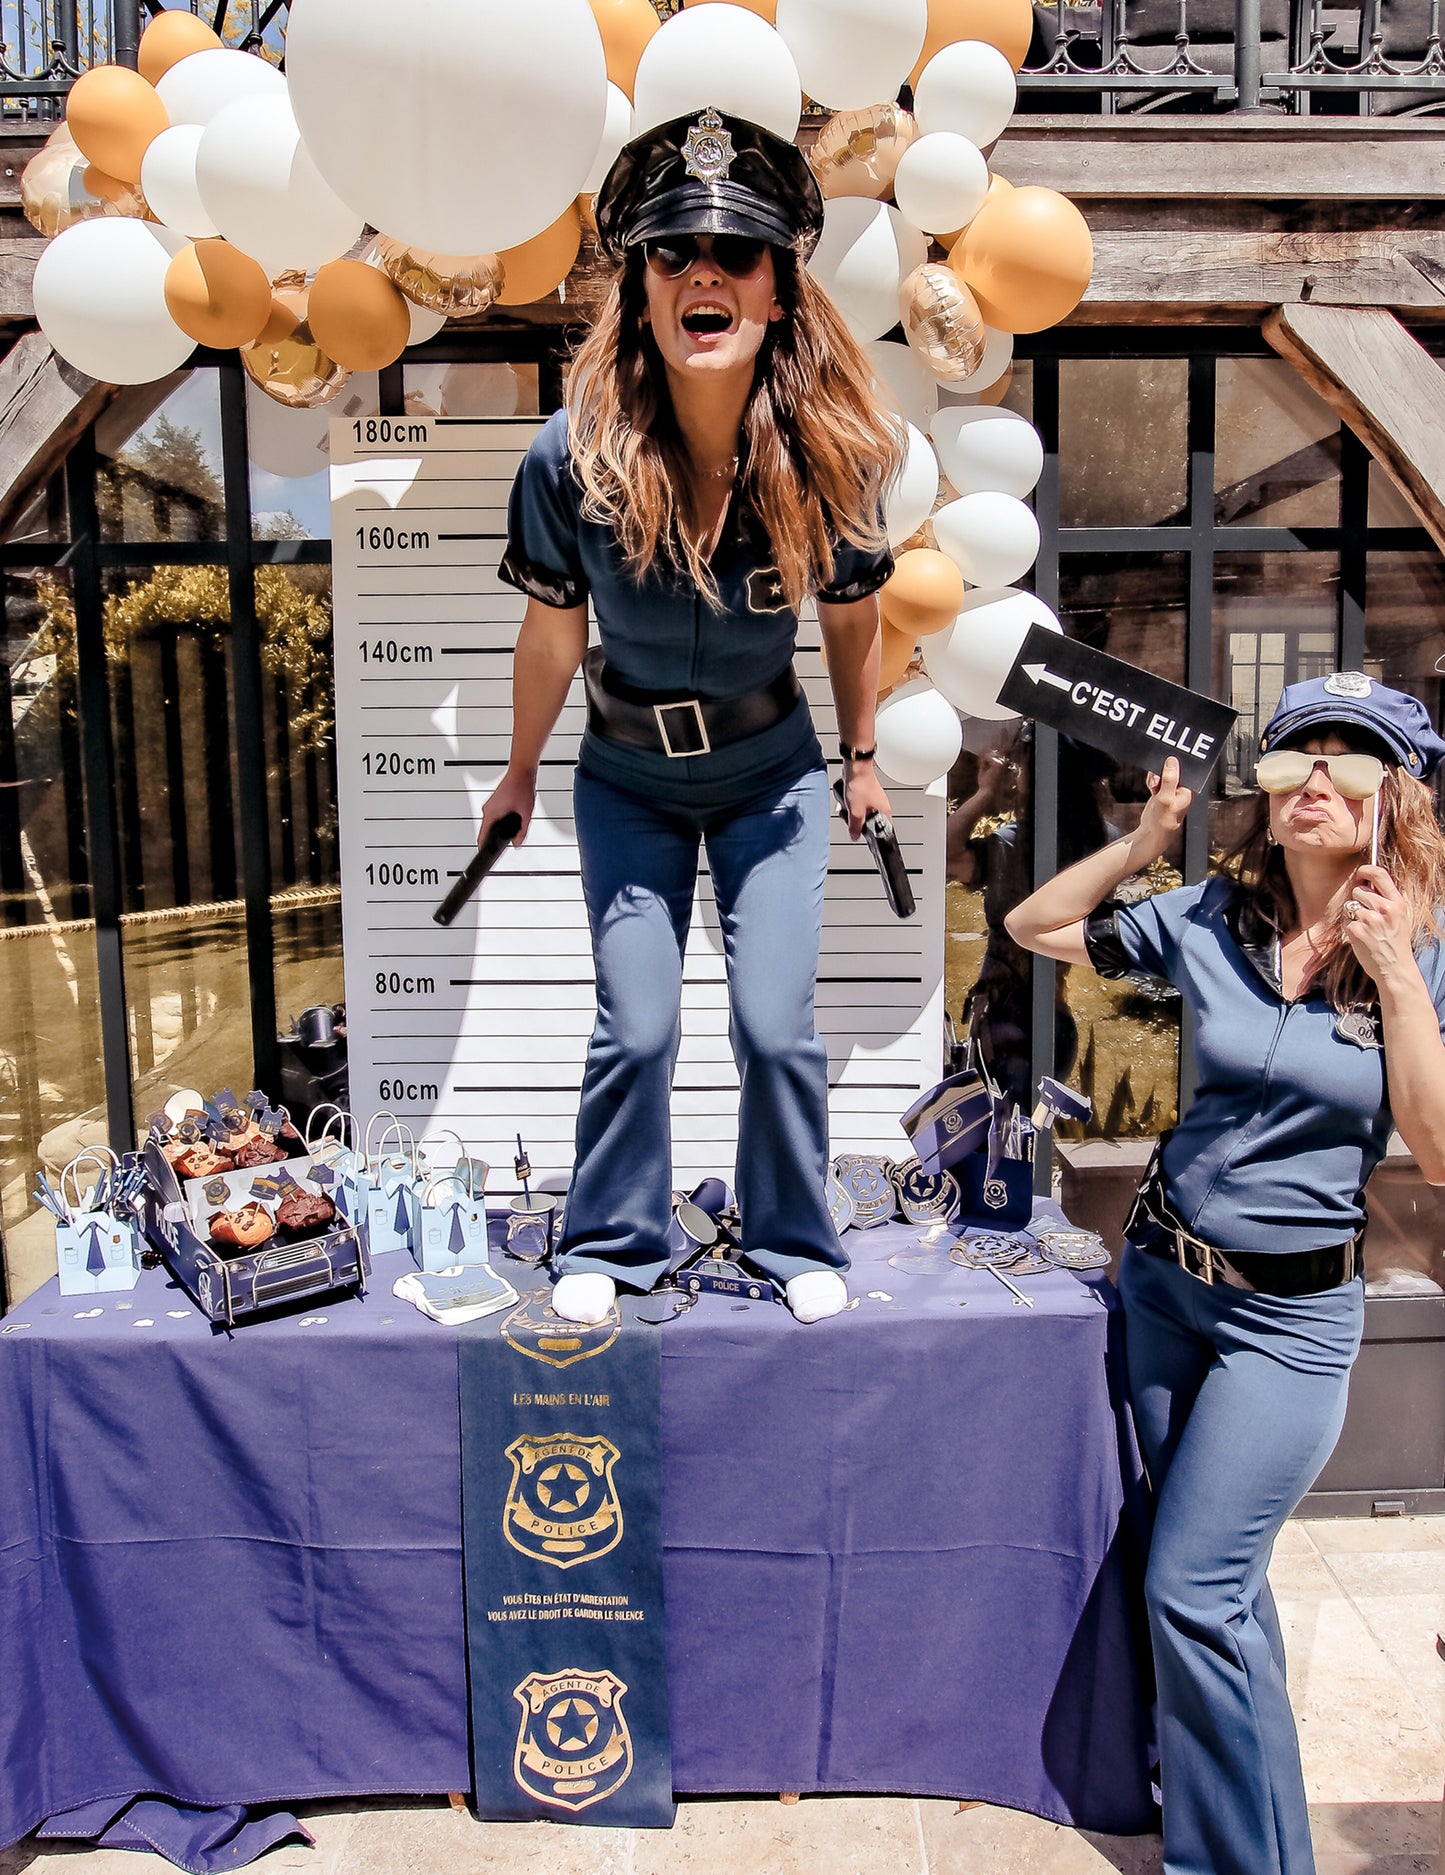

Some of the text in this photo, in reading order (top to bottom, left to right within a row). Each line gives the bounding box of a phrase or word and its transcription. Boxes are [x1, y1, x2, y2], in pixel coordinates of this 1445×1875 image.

[352, 420, 428, 443] 180cm
[355, 527, 430, 550] 160cm
[358, 641, 433, 664] 140cm
[1071, 681, 1215, 760] C'EST ELLE
[361, 752, 436, 775] 120cm
[365, 863, 439, 885] 100cm
[375, 972, 435, 994] 80cm
[379, 1079, 438, 1101] 60cm
[712, 1280, 740, 1292] POLICE
[513, 1392, 611, 1407] LES MAINS EN L'AIR
[534, 1446, 593, 1460] AGENT DE
[531, 1519, 599, 1536] POLICE
[503, 1592, 629, 1606] VOUS ÊTES EN ÉTAT D'ARRESTATION
[487, 1608, 645, 1621] VOUS AVEZ LE DROIT DE GARDER LE SILENCE
[542, 1680, 600, 1698] AGENT DE
[541, 1755, 609, 1775] POLICE
